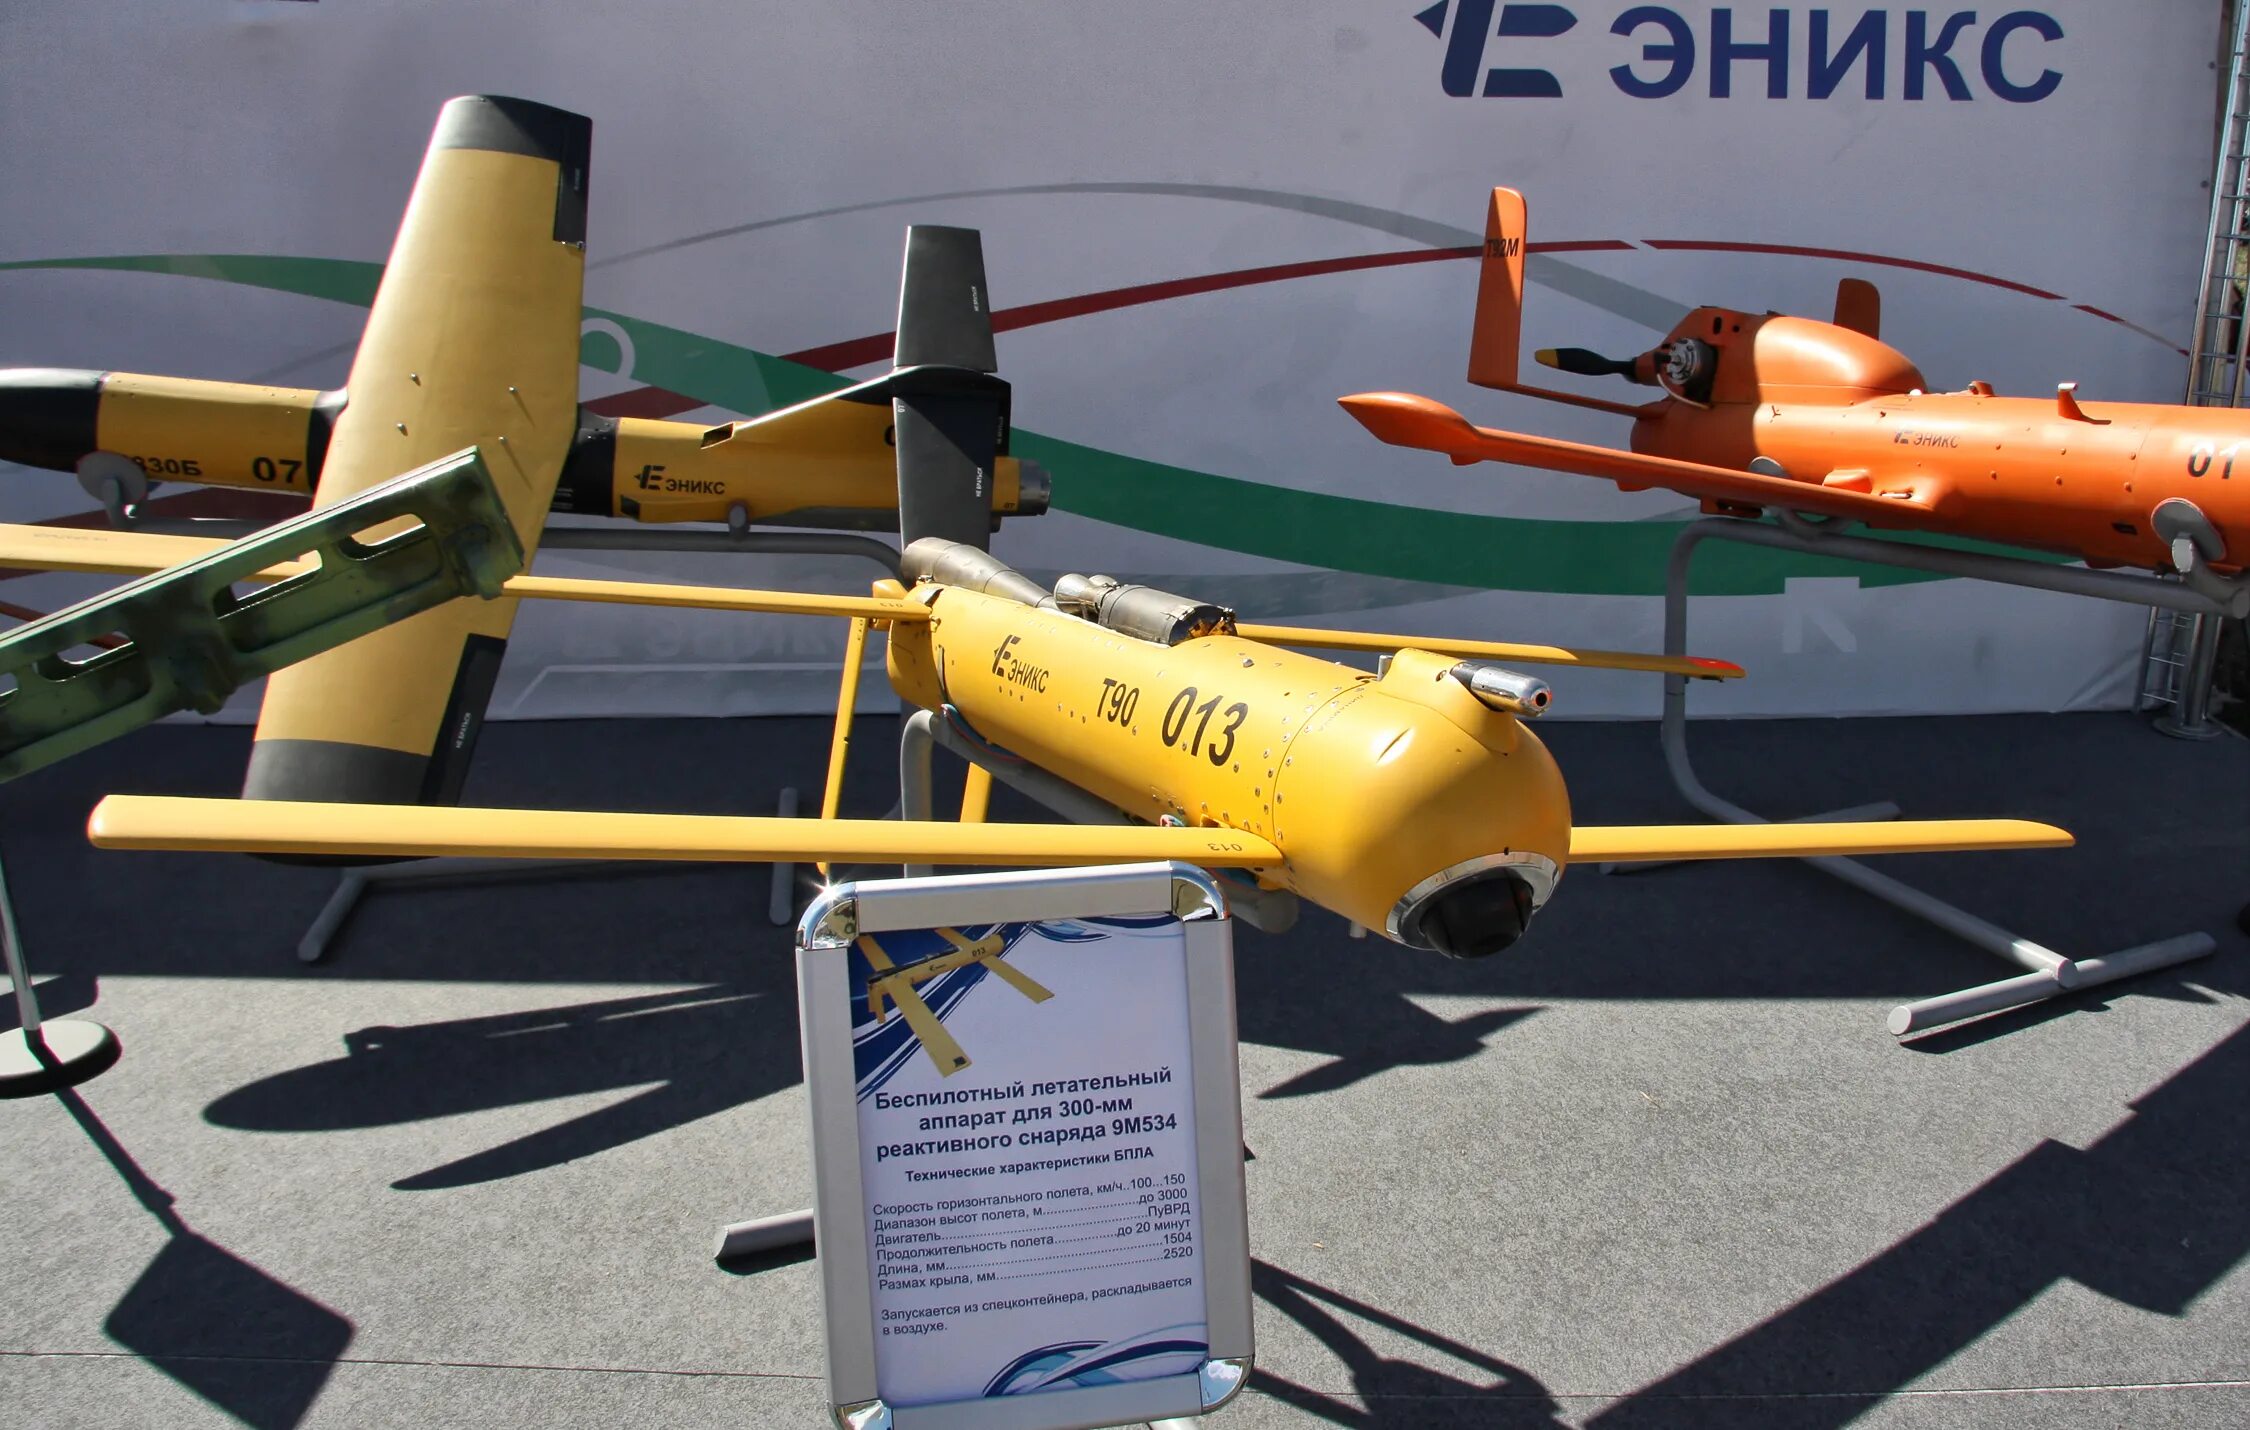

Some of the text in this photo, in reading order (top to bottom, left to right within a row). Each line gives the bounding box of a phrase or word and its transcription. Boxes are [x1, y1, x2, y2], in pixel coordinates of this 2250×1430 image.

[1609, 6, 2065, 103] ЭНИКС
[1913, 432, 1960, 448] ЭНИКС
[252, 457, 303, 483] 07
[665, 479, 726, 495] ЭНИКС
[1008, 658, 1049, 693] ЭНИКС
[1162, 687, 1248, 767] 013
[875, 1066, 1171, 1109] Беспилотный летательный
[919, 1098, 1132, 1130] аппарат для 300-мм
[877, 1113, 1177, 1162] реактивного снаряда 9М534
[905, 1147, 1154, 1182] Технические характеристики БПЛА
[873, 1203, 933, 1216] Скорость
[937, 1192, 1042, 1211] горизонтального
[1047, 1187, 1093, 1199] полета,
[874, 1218, 935, 1232] Диапазон
[940, 1214, 978, 1225] высот
[982, 1209, 1029, 1221] полета,
[1158, 1188, 1187, 1201] 3000
[877, 1241, 1007, 1261] Продолжительность
[1135, 1221, 1150, 1233] 20
[1154, 1219, 1191, 1234] минут
[878, 1264, 922, 1278] Длина,
[879, 1279, 926, 1290] Размах
[930, 1275, 972, 1288] крыла,
[881, 1278, 1191, 1321] Запускается из спецконтейнера, раскладывается
[883, 1322, 947, 1335] в воздухе.
